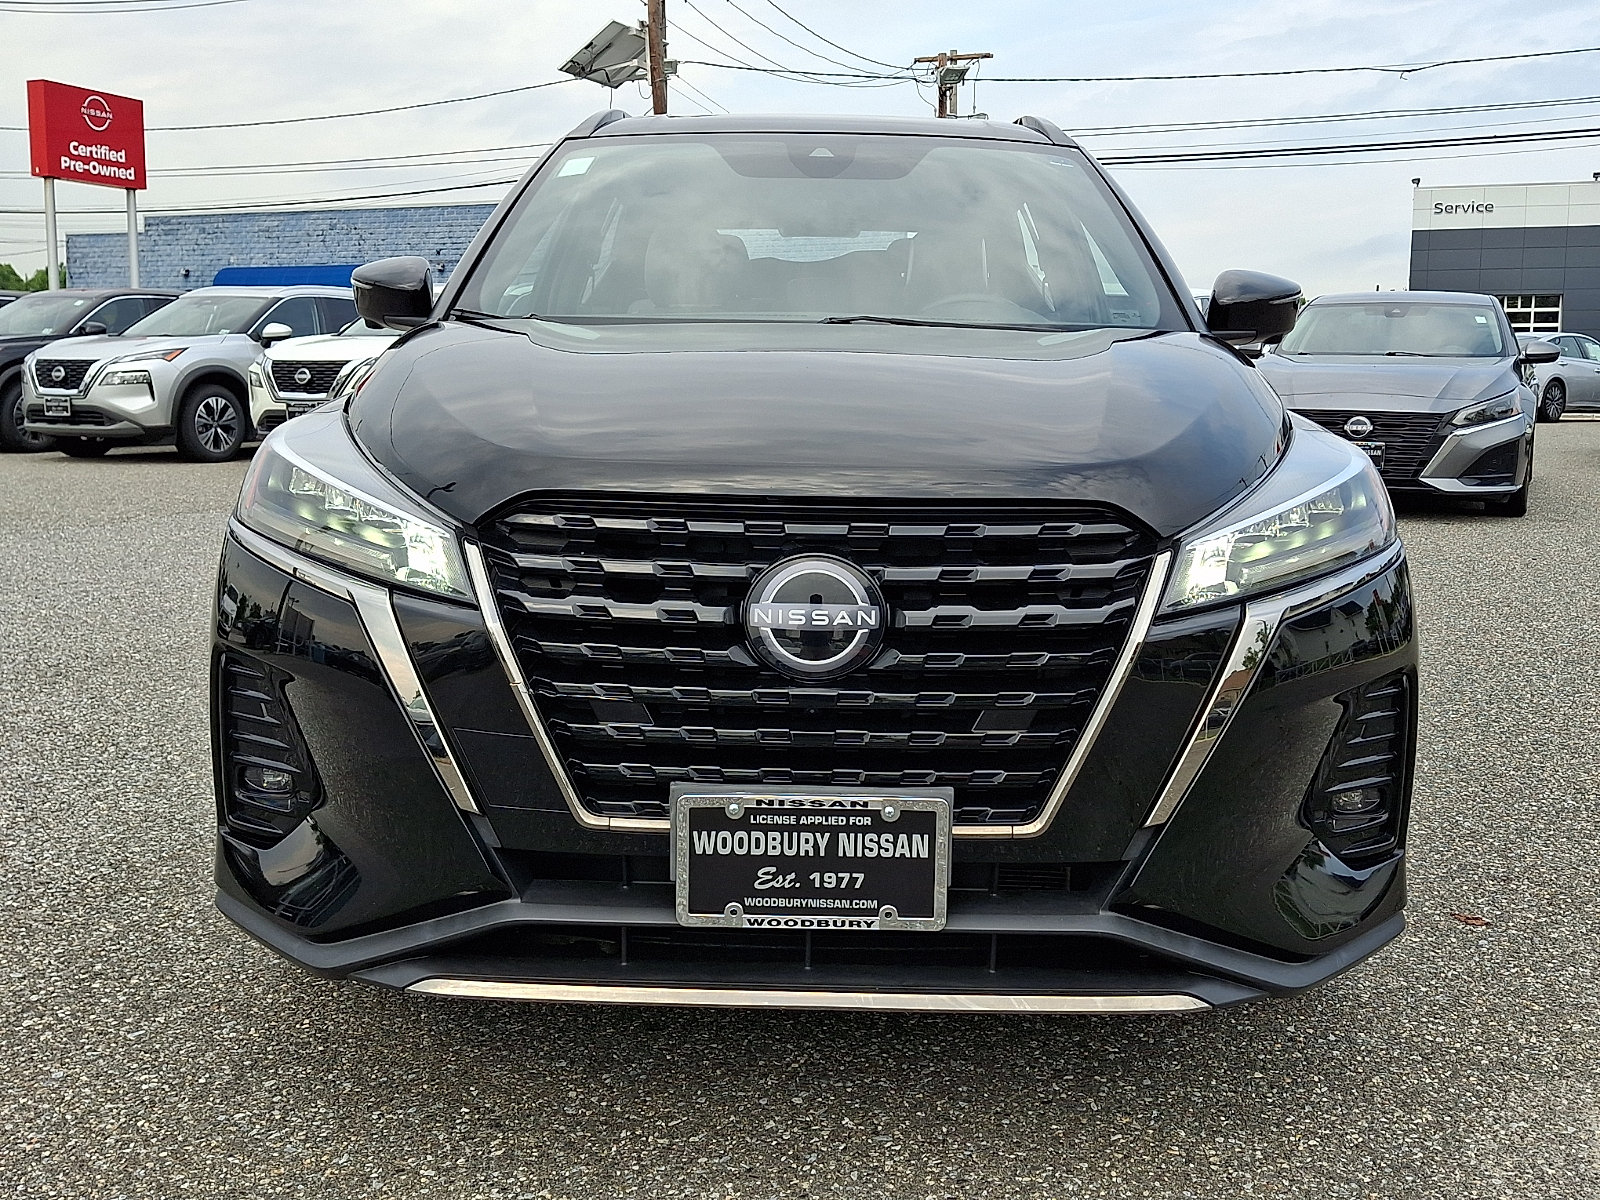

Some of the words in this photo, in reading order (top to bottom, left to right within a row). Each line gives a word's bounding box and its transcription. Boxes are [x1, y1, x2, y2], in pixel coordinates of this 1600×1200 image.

[81, 107, 113, 119] NISSAN
[69, 141, 126, 163] Certified
[60, 156, 135, 180] Pre-Owned
[1434, 200, 1494, 214] Service
[754, 608, 876, 626] NISSAN
[755, 799, 869, 809] NISSAN
[750, 814, 797, 825] LICENSE
[799, 815, 847, 826] APPLIED
[849, 816, 872, 826] FOR
[692, 830, 831, 857] WOODBURY
[838, 832, 929, 858] NISSAN
[753, 866, 801, 890] Est.
[809, 872, 865, 889] 1977
[743, 897, 878, 910] WOODBURYNISSAN.COM
[746, 918, 876, 929] WOODBURY
